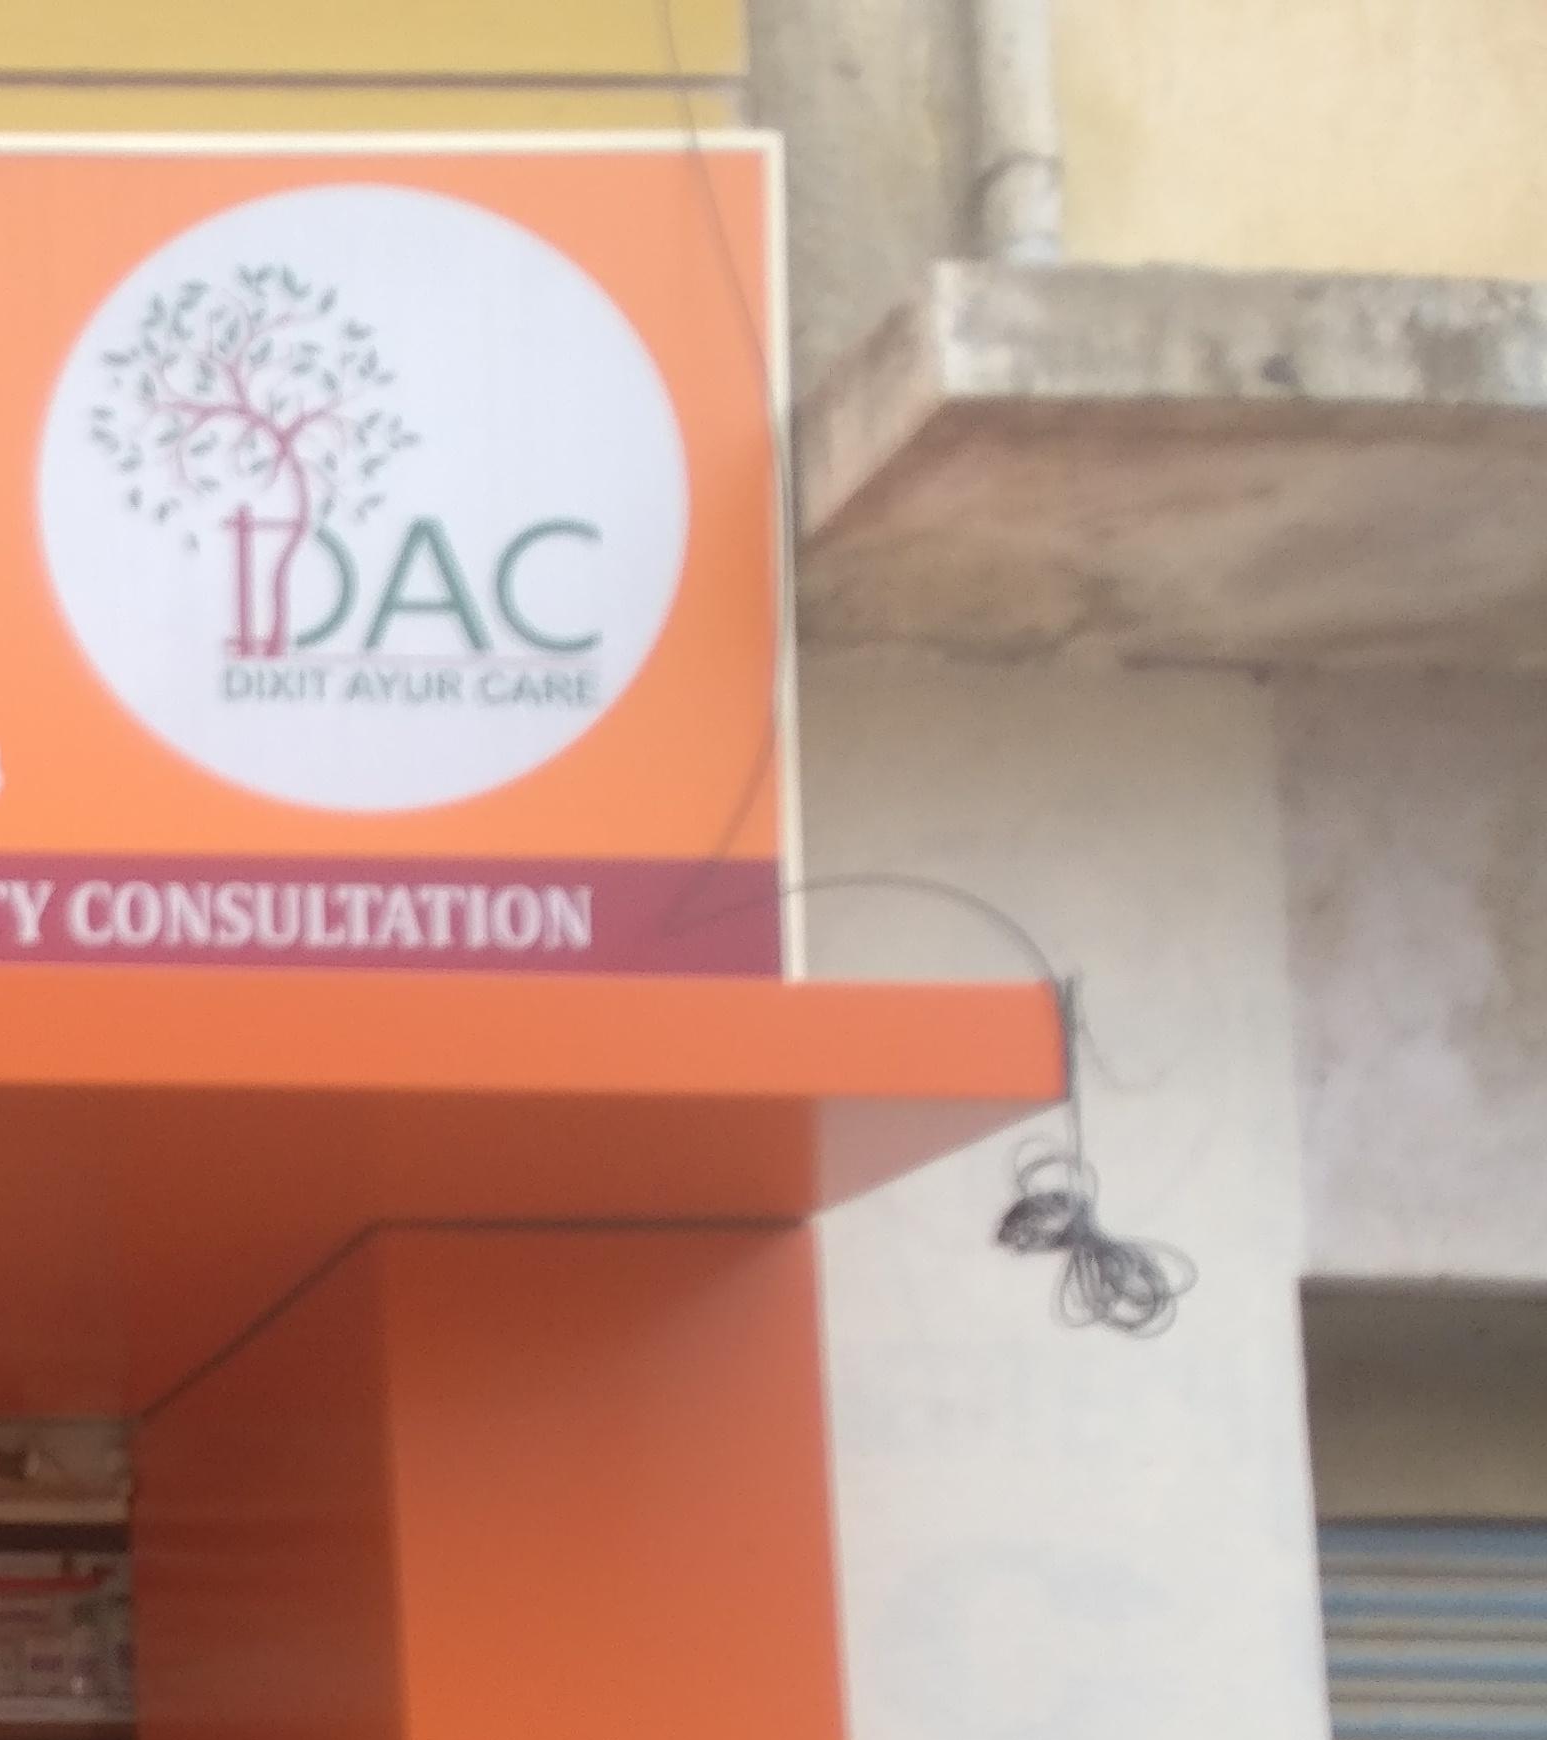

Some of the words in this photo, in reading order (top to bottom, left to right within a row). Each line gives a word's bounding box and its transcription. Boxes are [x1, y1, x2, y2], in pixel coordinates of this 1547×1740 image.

[223, 515, 604, 657] DAC
[223, 667, 327, 702] DIXIT
[341, 667, 463, 704] AYUR
[477, 668, 599, 706] CARE
[68, 882, 591, 948] CONSULTATION
